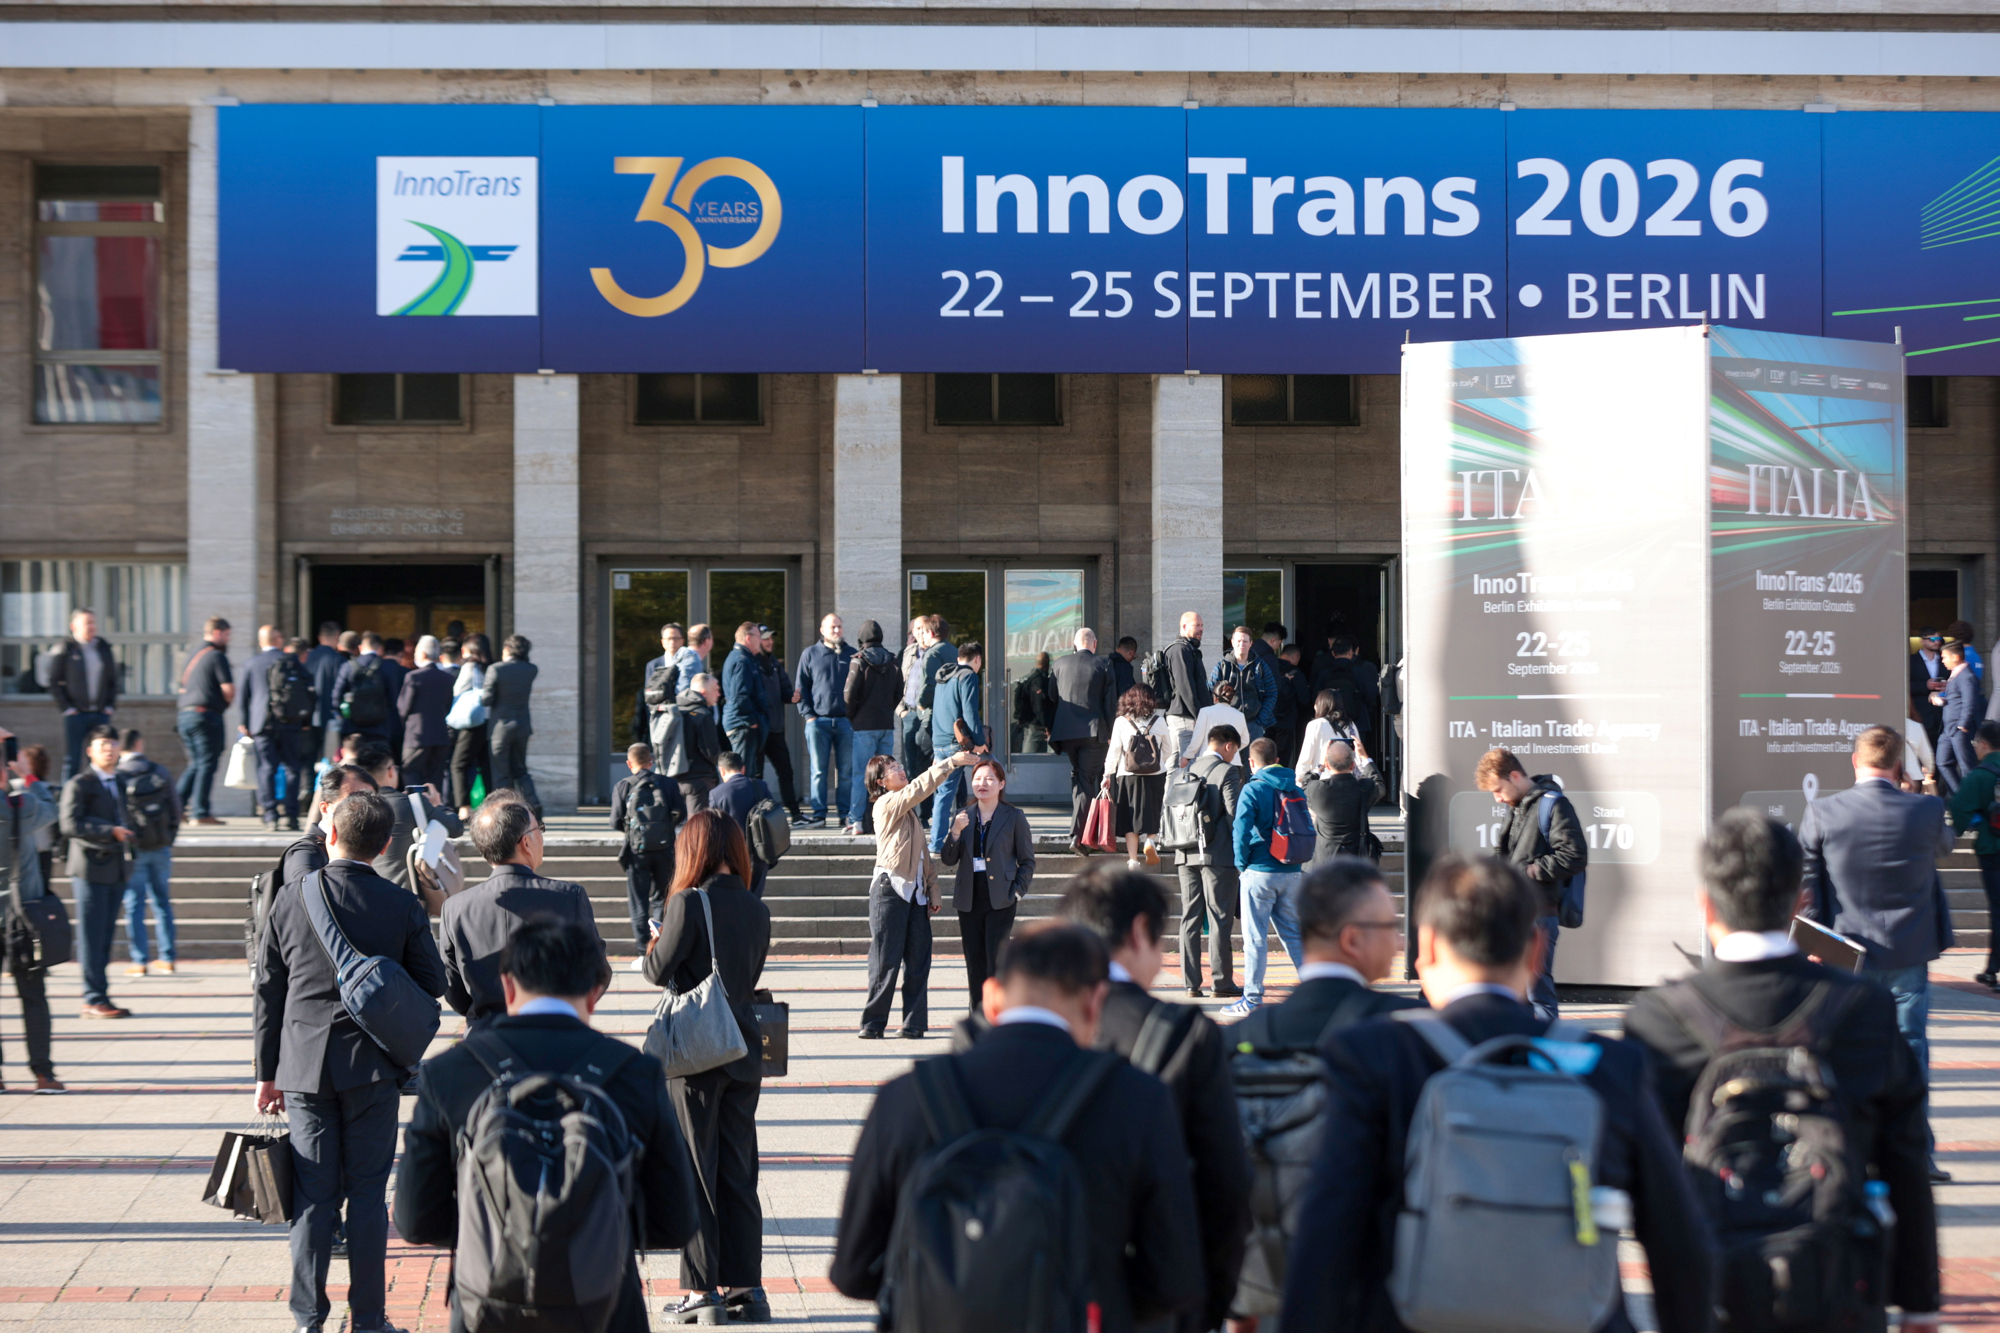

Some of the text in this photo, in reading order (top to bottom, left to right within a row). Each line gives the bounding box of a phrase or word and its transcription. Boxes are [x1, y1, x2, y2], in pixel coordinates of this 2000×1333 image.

[394, 170, 522, 196] InnoTrans
[942, 156, 1768, 238] InnoTrans 2026
[694, 201, 759, 216] YEARS
[694, 216, 759, 224] ANNIVERSARY
[590, 156, 782, 318] 30
[940, 270, 1004, 317] 22
[1069, 270, 1133, 318] 25
[1153, 270, 1496, 319] SEPTEMBER
[1567, 272, 1765, 321] BERLIN
[1456, 468, 1548, 522] ITA
[1744, 463, 1878, 522] ITALIA
[401, 523, 465, 535] ENTRANCE
[1755, 569, 1865, 594] InnoTrans 2026
[1483, 601, 1514, 613] Berlin
[1762, 598, 1856, 612] Berlin Exhibition Grounds
[1516, 631, 1591, 658] 22-25
[1784, 630, 1836, 656] 22-25
[1507, 661, 1568, 677] September
[1778, 660, 1820, 676] September
[1449, 720, 1476, 738] ITA
[1491, 719, 1541, 738] Italian
[1545, 718, 1594, 738] Trade
[1739, 718, 1760, 737] ITA
[1768, 718, 1803, 736] Italian
[1804, 718, 1838, 736] Trade
[1511, 743, 1529, 754] and
[1532, 742, 1590, 754] Investment
[1766, 742, 1854, 753] Info and Investment Desk
[1593, 805, 1625, 818] Stand
[1768, 804, 1784, 817] Hall
[1586, 823, 1635, 850] 170
